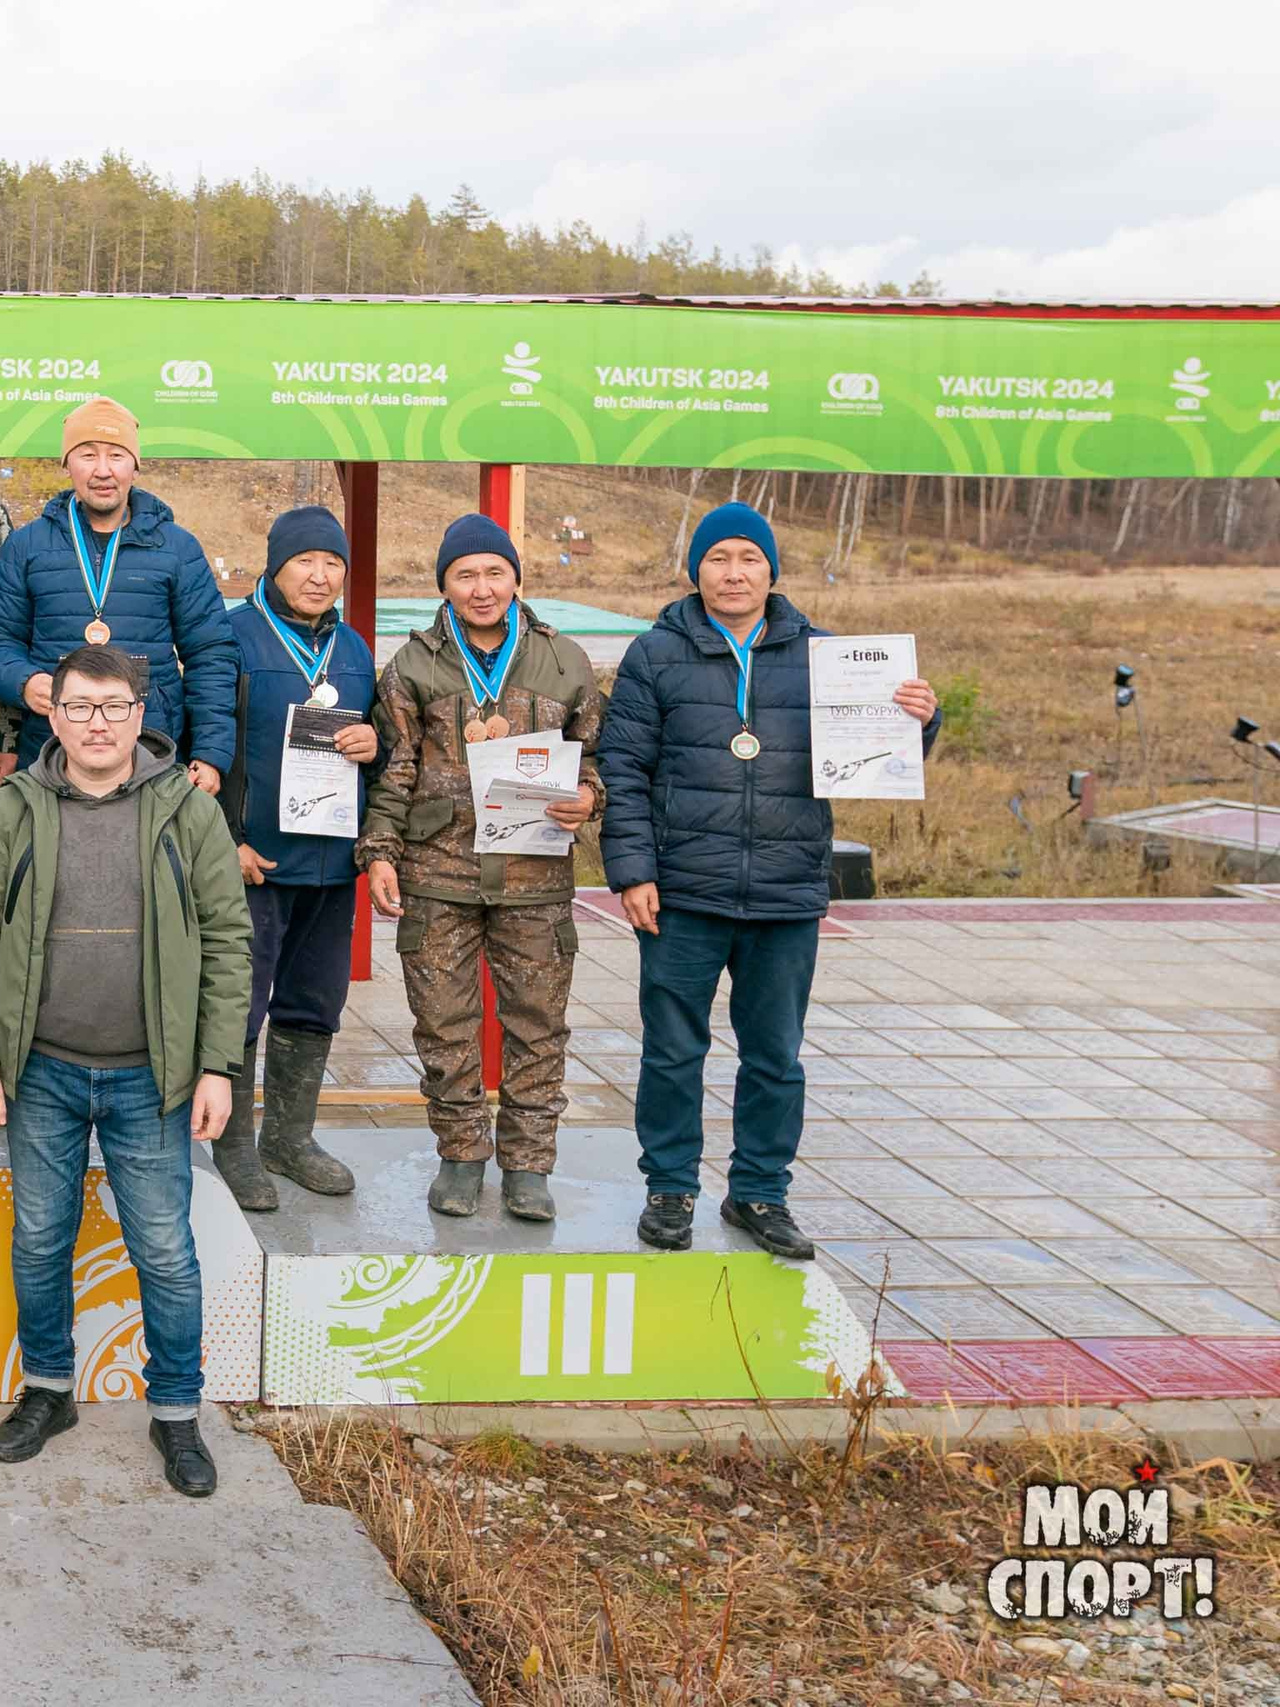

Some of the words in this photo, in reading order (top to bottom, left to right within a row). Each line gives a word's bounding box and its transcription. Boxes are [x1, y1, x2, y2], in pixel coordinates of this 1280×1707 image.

[38, 359, 101, 380] 2024
[272, 362, 382, 383] YAKUTSK
[387, 363, 448, 384] 2024
[595, 367, 704, 388] YAKUTSK
[709, 369, 770, 390] 2024
[6, 388, 20, 401] of
[22, 389, 52, 401] Asia
[938, 376, 1048, 398] YAKUTSK
[1053, 378, 1114, 400] 2024
[272, 391, 295, 404] 8th
[298, 392, 352, 405] Children
[355, 392, 369, 405] of
[371, 393, 400, 406] Asia
[402, 394, 448, 406] Games
[594, 396, 617, 408] 8th
[620, 397, 674, 410] Children
[676, 398, 690, 410] of
[693, 398, 721, 411] Asia
[723, 399, 769, 412] Games
[852, 650, 889, 662] Егерь
